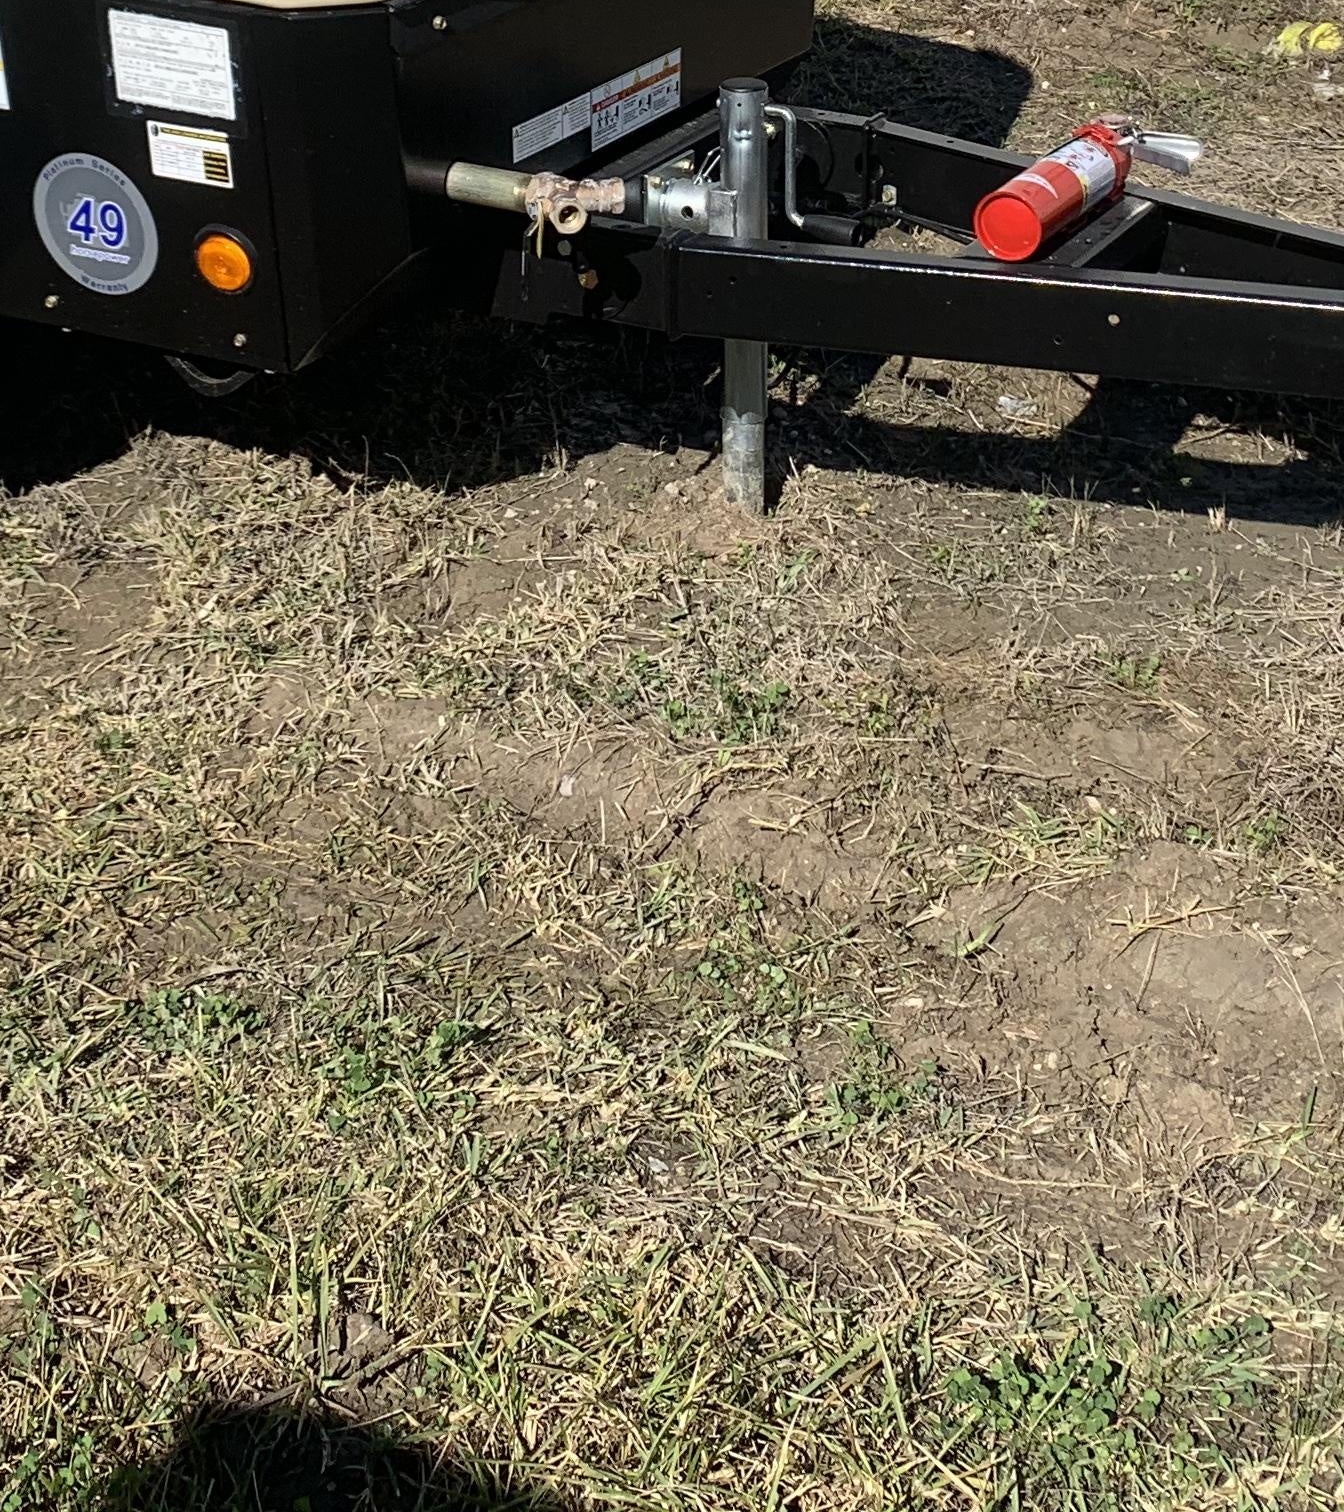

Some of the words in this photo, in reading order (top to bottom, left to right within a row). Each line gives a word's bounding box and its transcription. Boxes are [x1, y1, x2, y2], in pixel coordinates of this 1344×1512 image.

[43, 157, 85, 182] Platinum
[91, 159, 127, 187] Series
[67, 196, 127, 249] 49
[81, 274, 129, 292] Warranty
